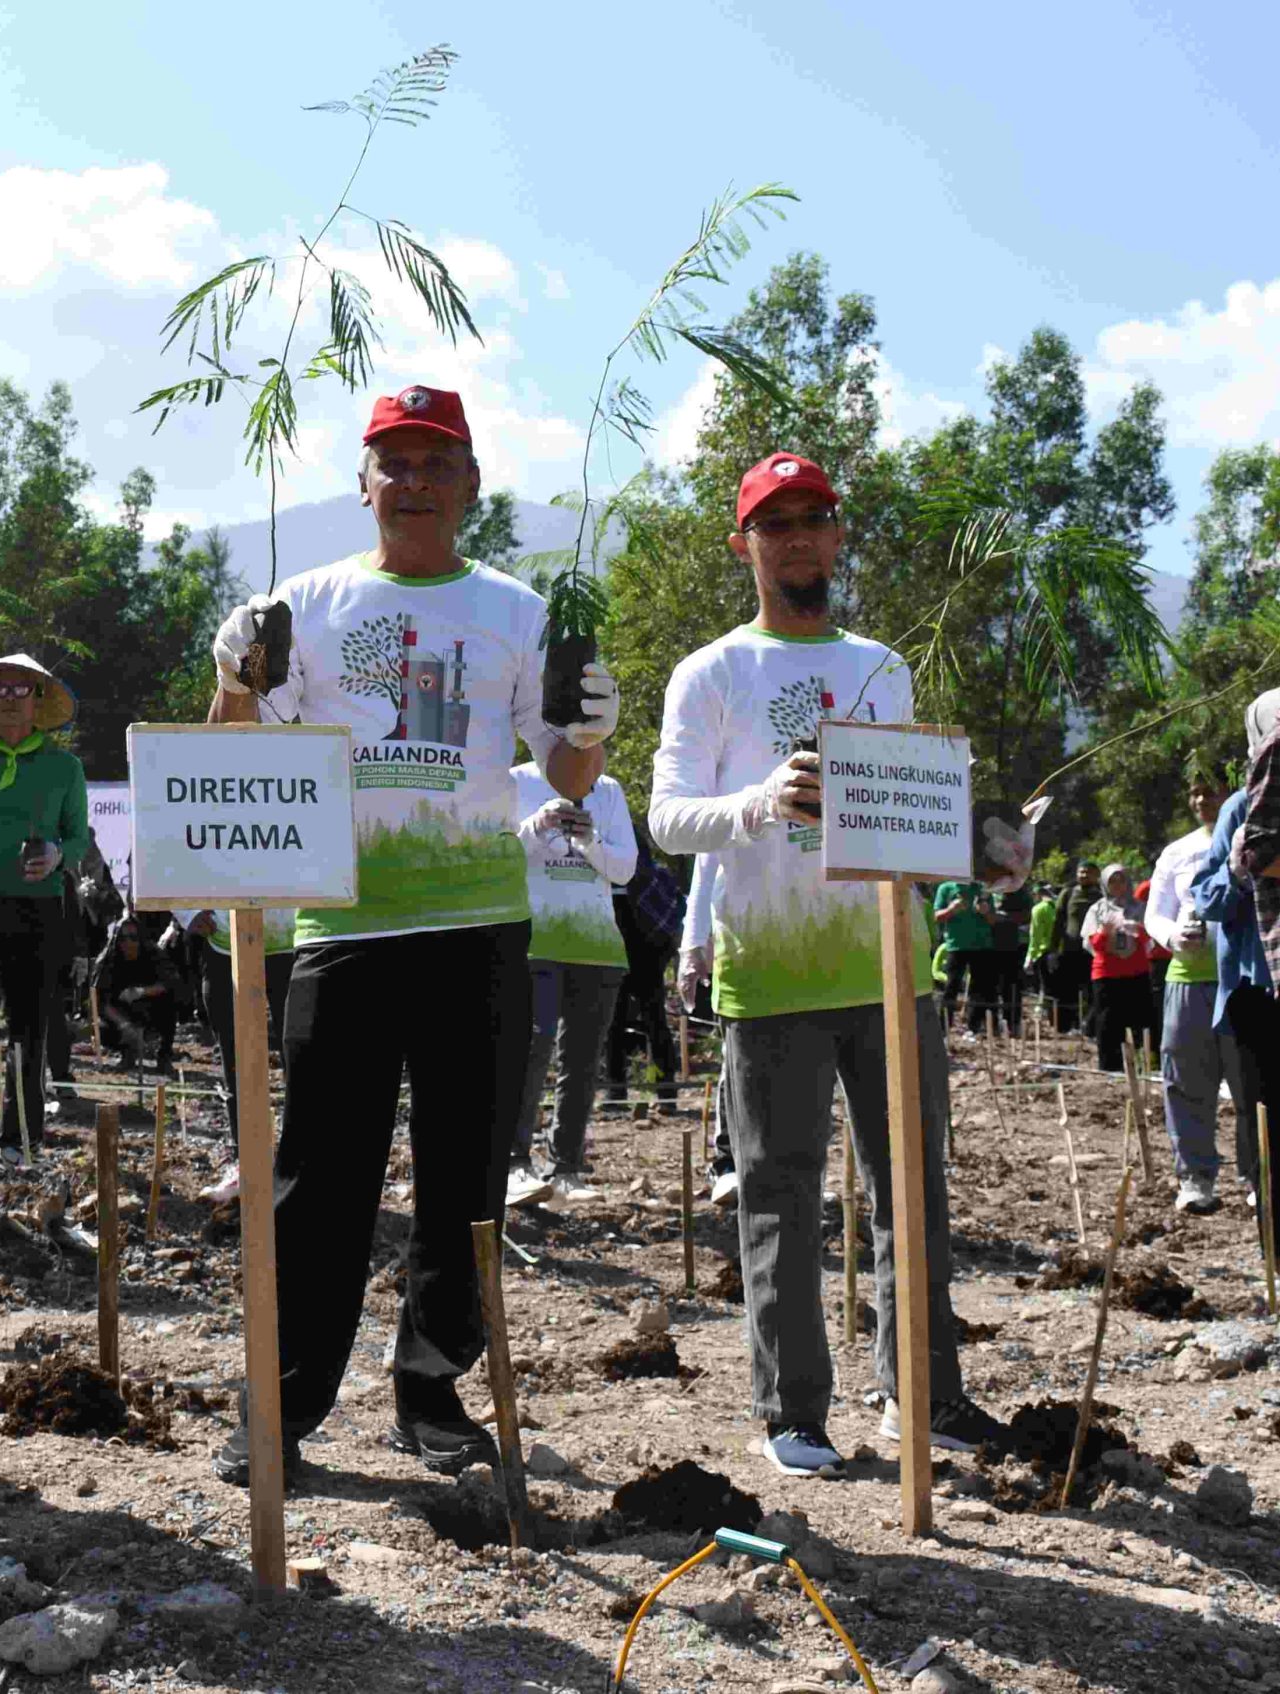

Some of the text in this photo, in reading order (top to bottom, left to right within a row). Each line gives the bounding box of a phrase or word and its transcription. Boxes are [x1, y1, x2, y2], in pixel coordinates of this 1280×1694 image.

[362, 766, 397, 775] POHON
[398, 766, 427, 775] MASA
[429, 768, 461, 778] DEPAN
[397, 778, 449, 789] INDONESIA
[830, 760, 962, 787] DINAS LINGKUNGAN
[166, 777, 319, 804] DIREKTUR
[845, 788, 952, 811] HIDUP PROVINSI
[186, 824, 303, 850] UTAMA
[838, 813, 959, 838] SUMATERA BARAT
